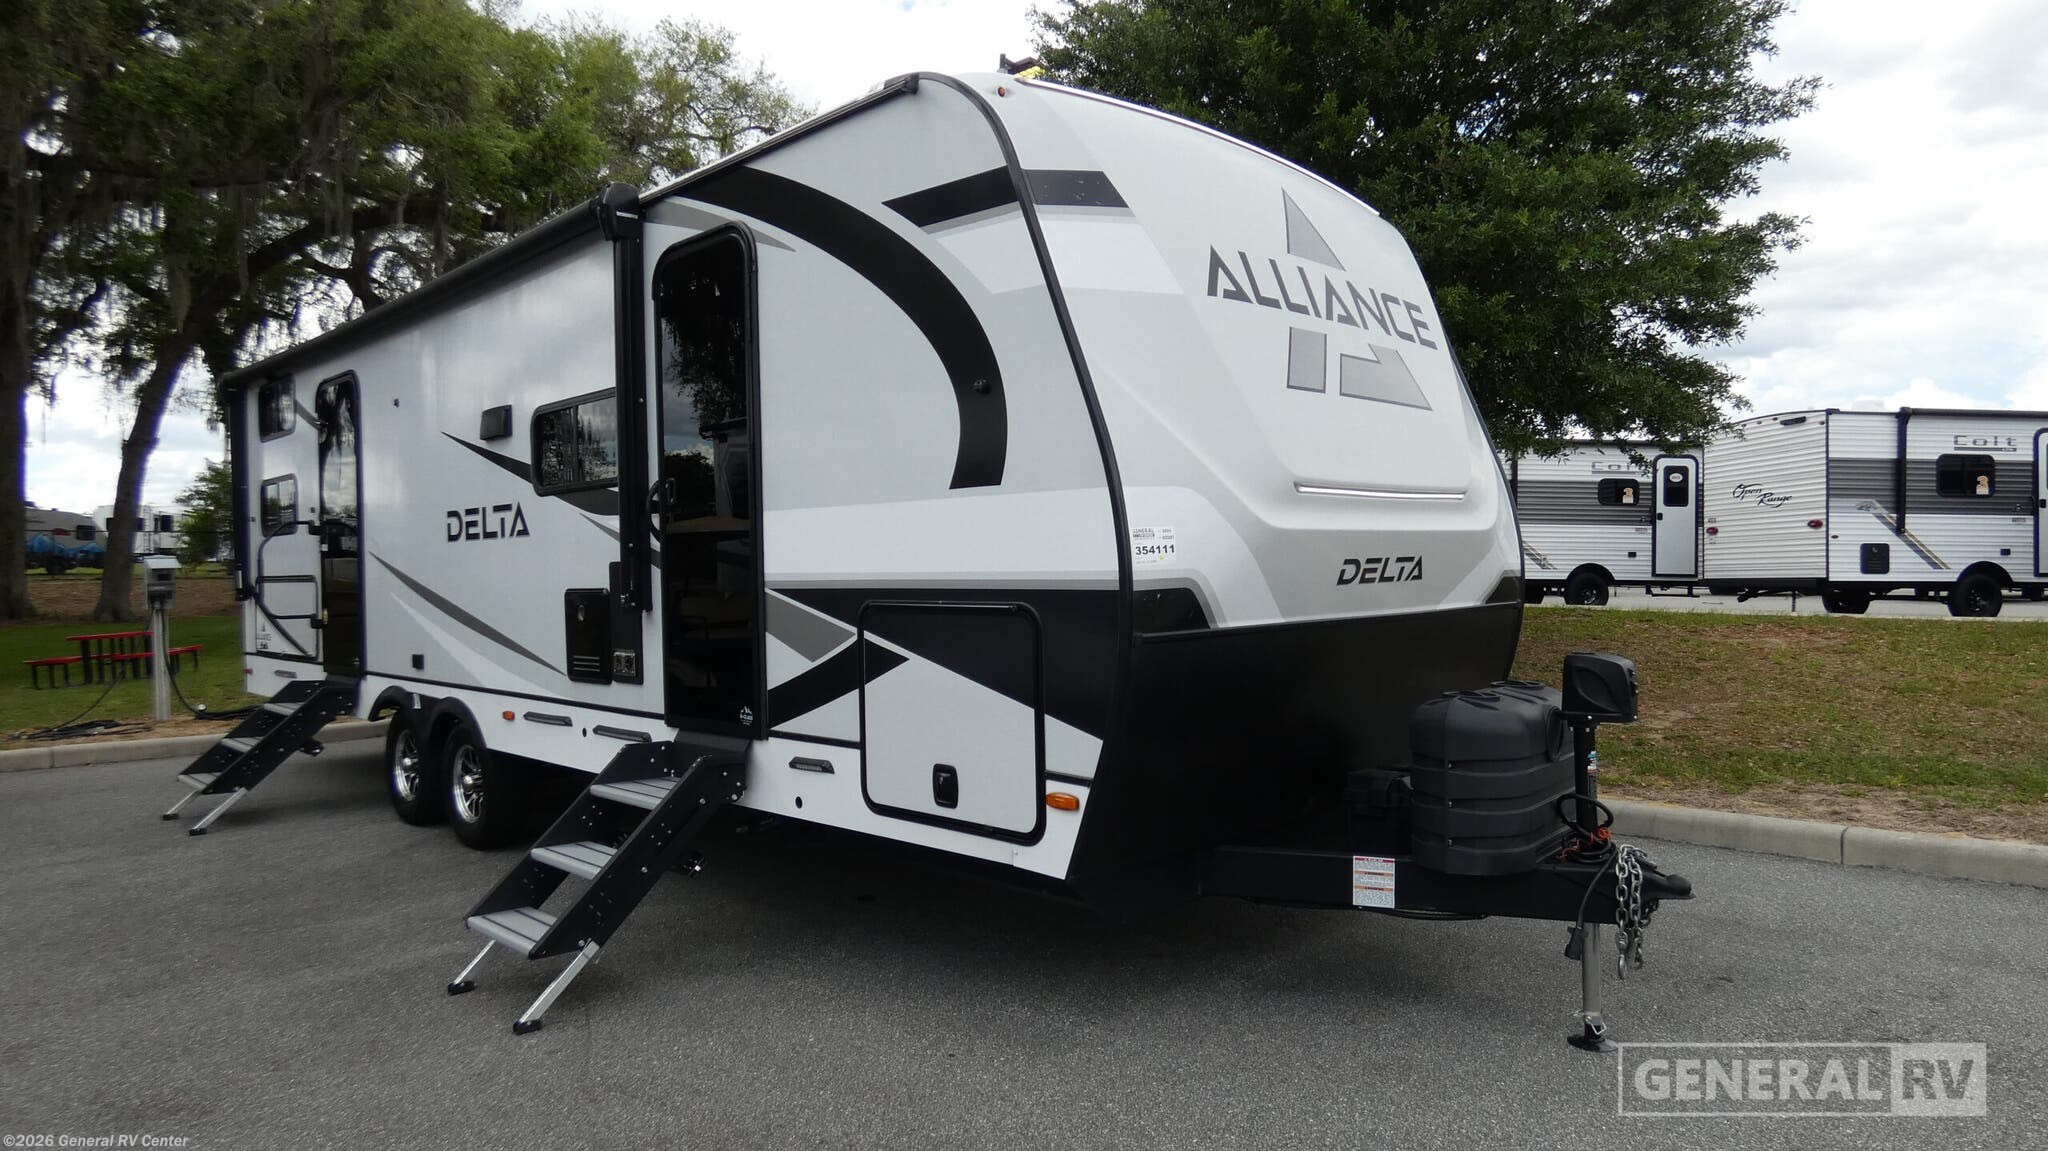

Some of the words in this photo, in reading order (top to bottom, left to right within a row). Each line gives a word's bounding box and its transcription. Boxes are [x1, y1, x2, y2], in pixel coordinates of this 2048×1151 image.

[1207, 244, 1438, 350] ALLIANCE
[1954, 435, 2016, 447] Colt
[1732, 483, 1763, 500] Open
[1756, 492, 1793, 508] Range
[447, 501, 530, 542] DELTA
[1135, 544, 1175, 556] 354111
[1336, 555, 1423, 586] DELTA
